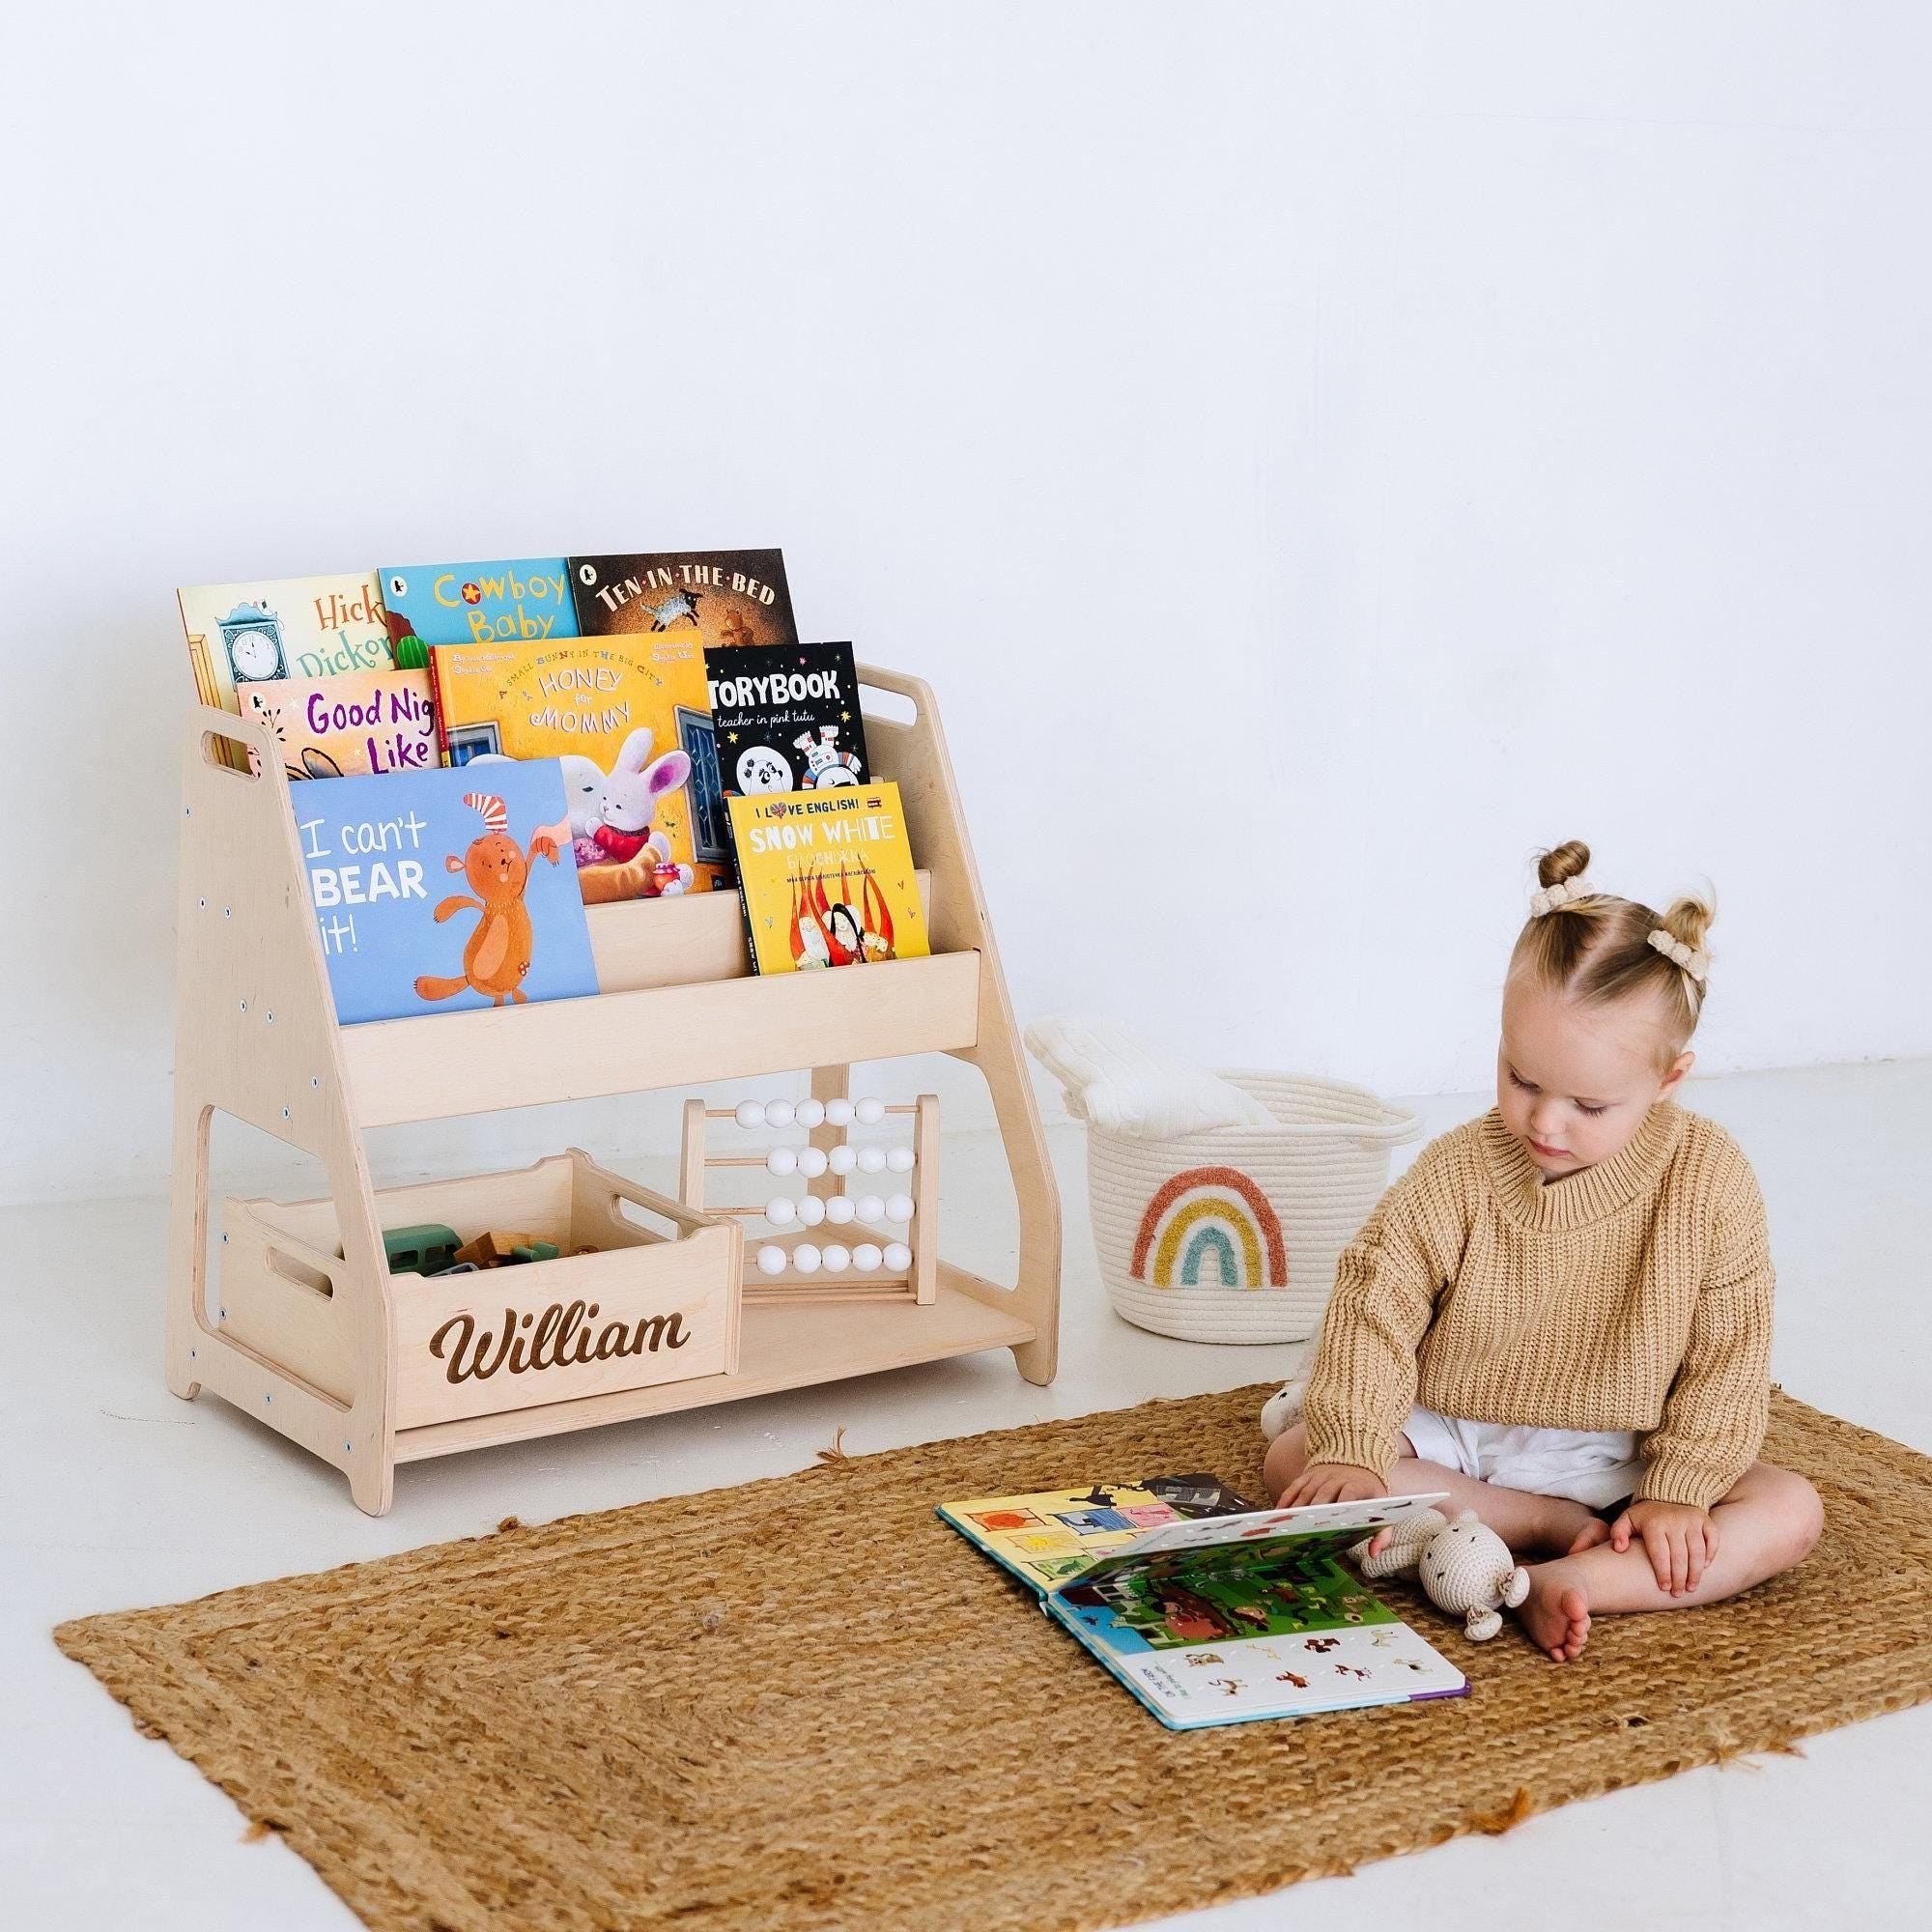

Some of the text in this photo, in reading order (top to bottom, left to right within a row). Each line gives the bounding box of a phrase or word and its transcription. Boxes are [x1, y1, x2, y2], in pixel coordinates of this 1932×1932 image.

[313, 584, 387, 631] Hick
[434, 570, 565, 608] Cowboy
[595, 564, 776, 611] TEN IN THE BED
[467, 605, 554, 643] Baby
[506, 662, 534, 687] SMALL
[536, 650, 575, 665] BUNNY
[579, 648, 589, 657] IN
[593, 650, 615, 660] THE
[618, 654, 634, 667] BIG
[637, 664, 664, 687] CITY
[538, 667, 623, 697] HONEY
[574, 694, 593, 705] for
[707, 669, 840, 710] TORYBOOK
[307, 689, 382, 734] Good
[390, 687, 435, 736] Nig
[528, 701, 631, 734] MOMMY
[717, 709, 815, 728] teacher in pink tutu
[367, 733, 429, 774] Like
[755, 808, 760, 818] I
[808, 798, 860, 815] ENGLISH!
[299, 810, 427, 859] I can't
[749, 822, 814, 853] SNOW
[822, 815, 896, 844] WHITE
[311, 860, 428, 908] BEAR
[319, 913, 358, 955] it!
[428, 1298, 692, 1384] William
